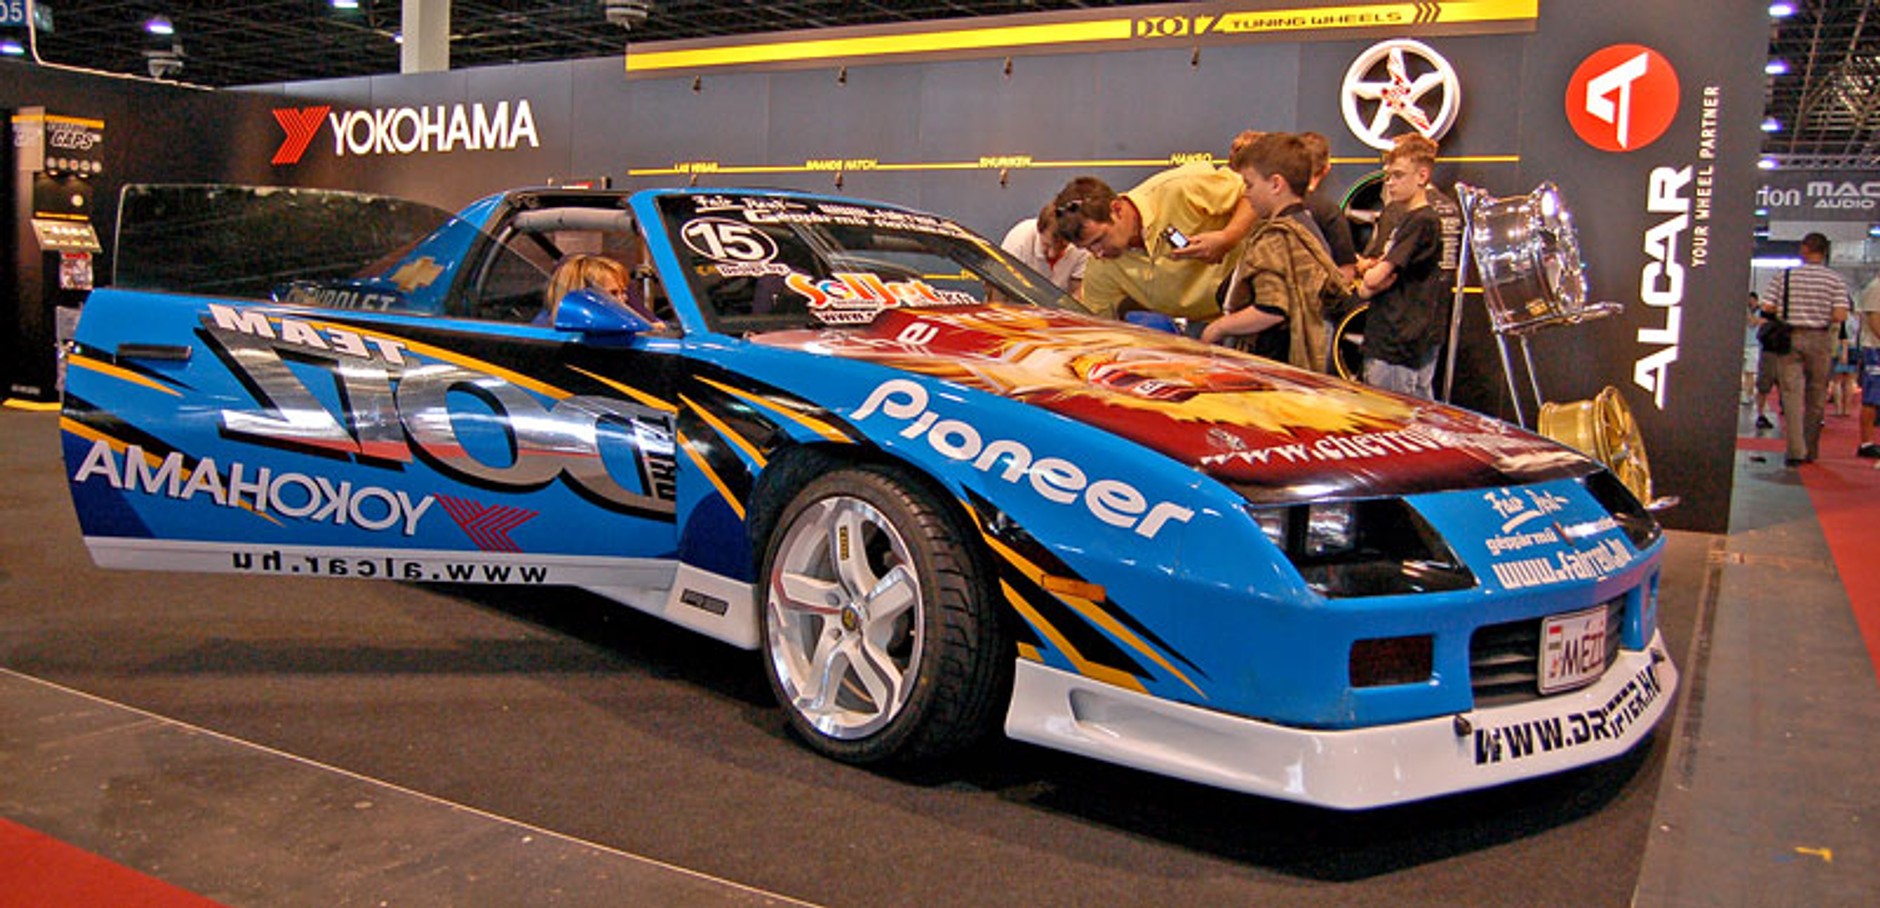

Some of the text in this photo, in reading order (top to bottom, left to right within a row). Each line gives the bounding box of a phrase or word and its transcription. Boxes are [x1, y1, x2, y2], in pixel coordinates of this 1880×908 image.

[1234, 18, 1306, 29] TUNING
[1311, 12, 1402, 26] WHEELS
[329, 100, 539, 156] YOKOHAMA
[1692, 86, 1720, 267] YOUR WHEEL PARTNER
[1814, 198, 1876, 209] AUDIO
[687, 222, 765, 260] 15
[1633, 165, 1693, 410] ALCAR
[851, 379, 1195, 539] Pioneer
